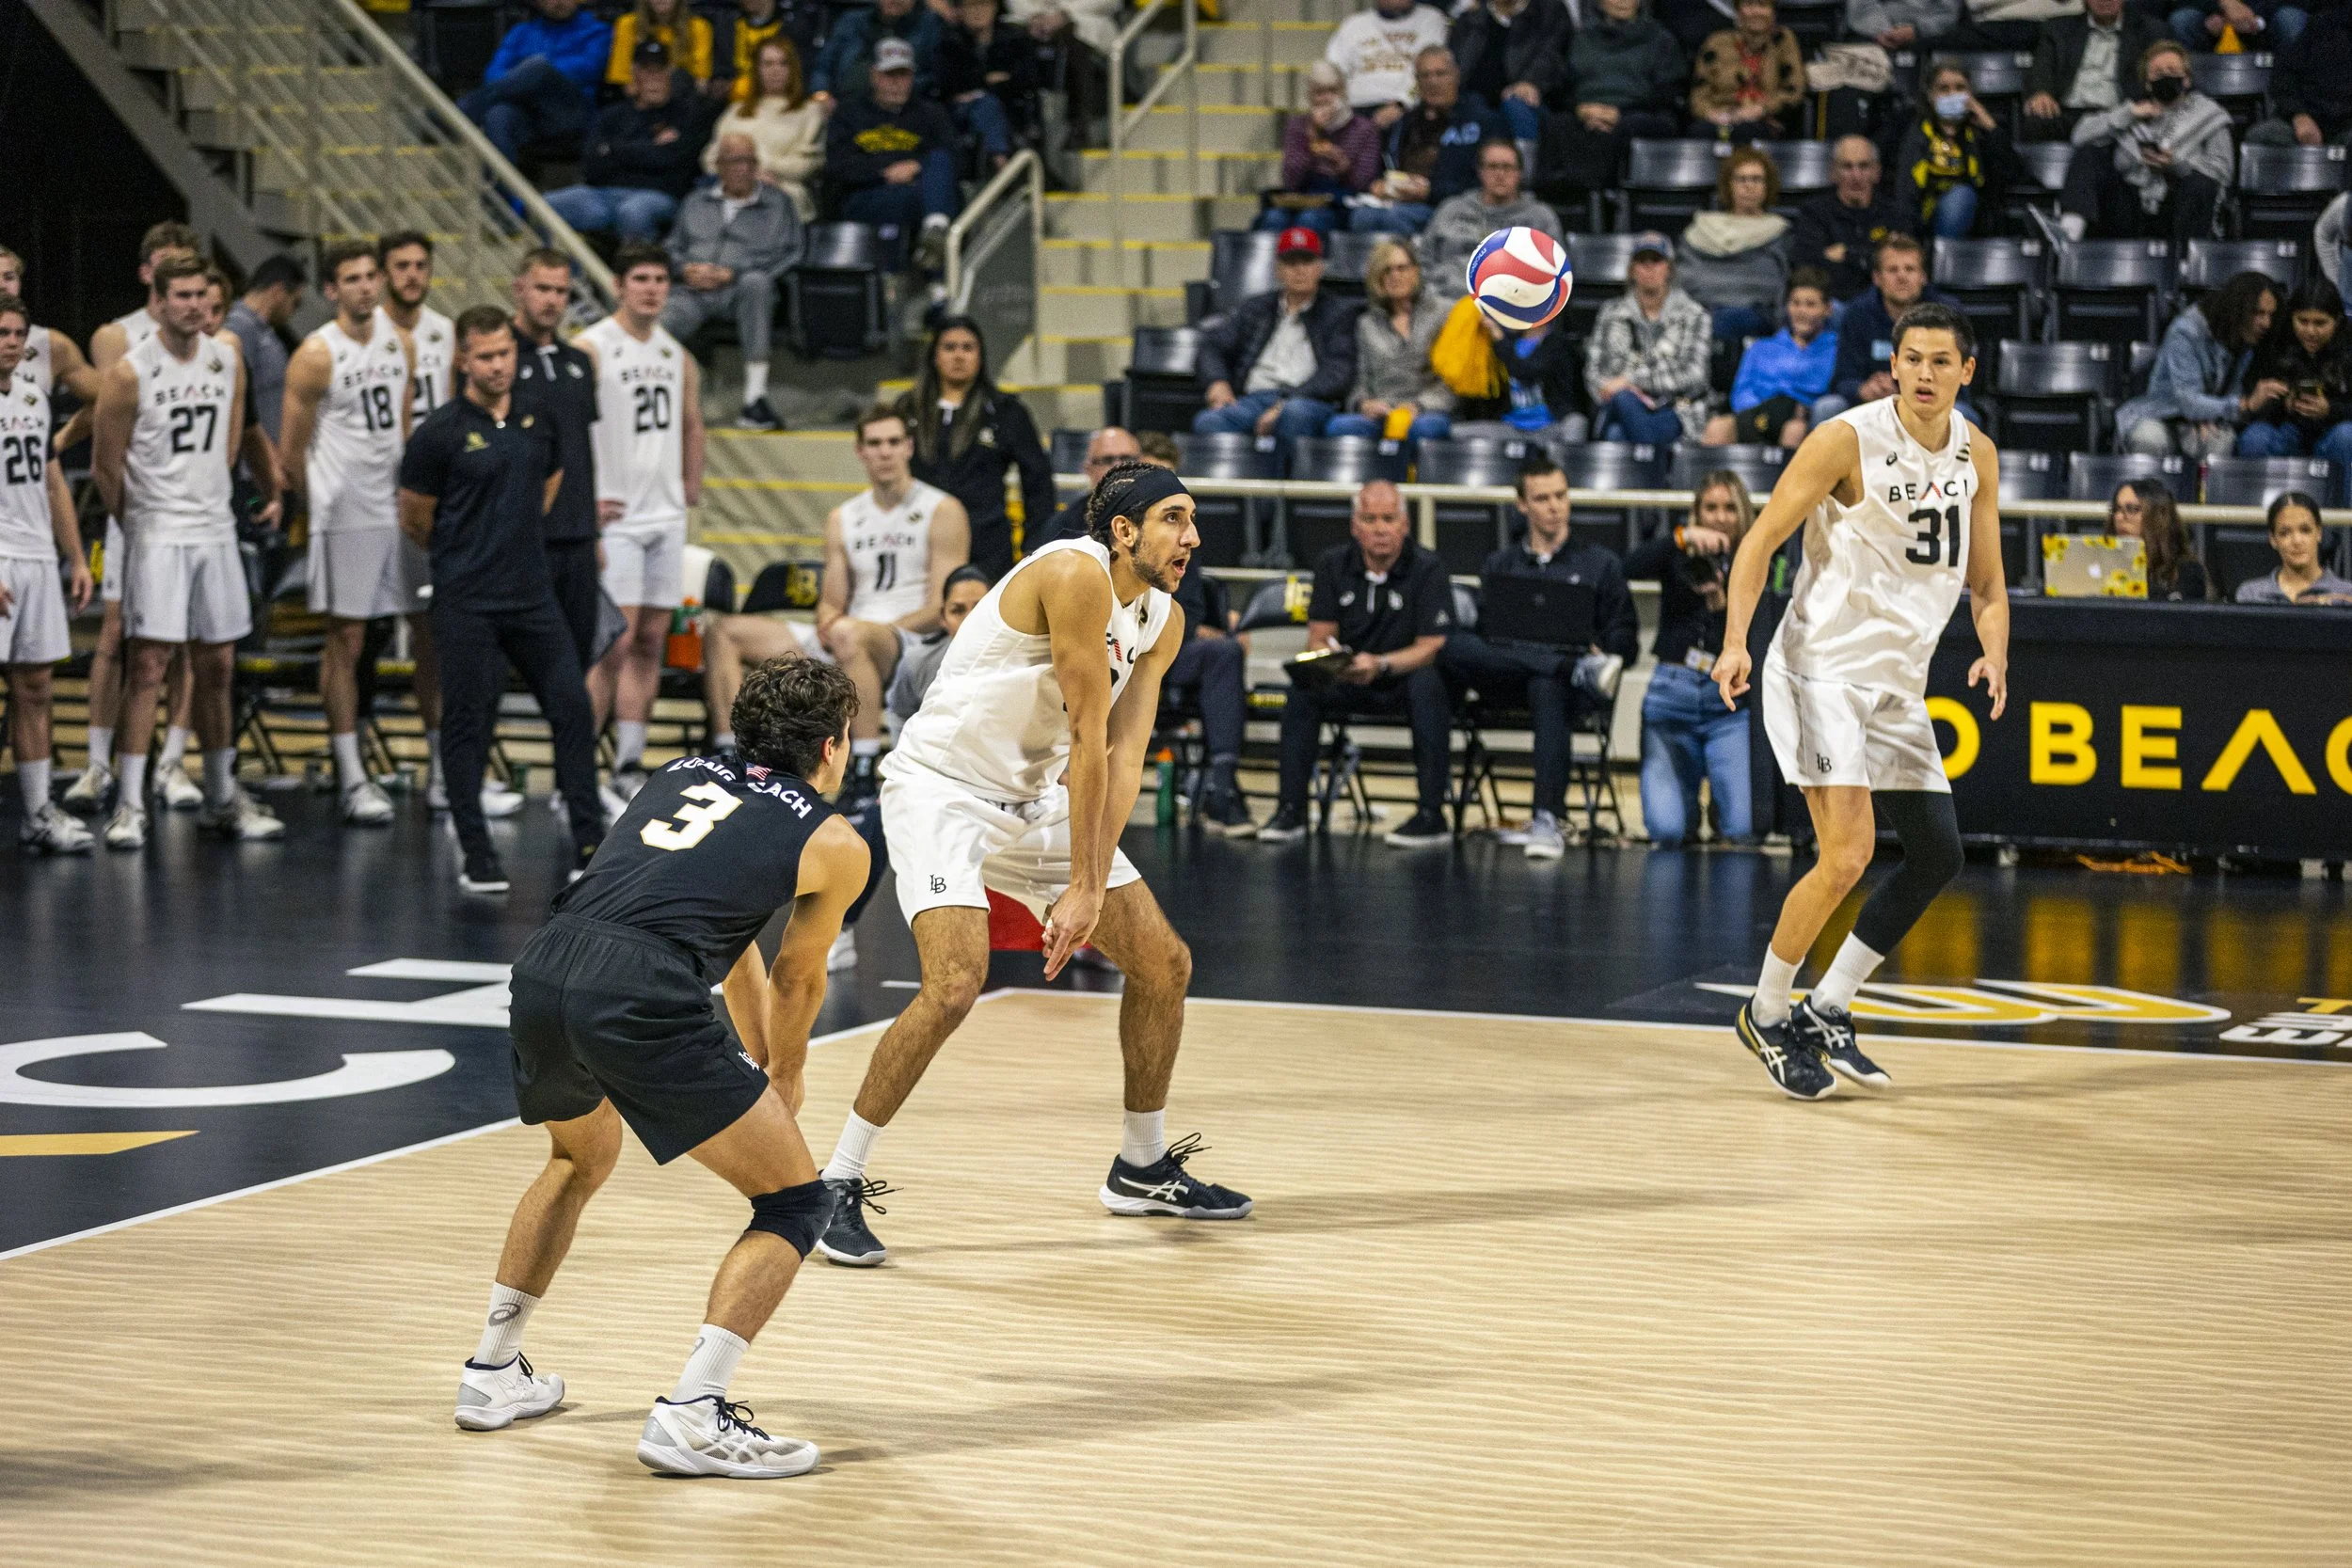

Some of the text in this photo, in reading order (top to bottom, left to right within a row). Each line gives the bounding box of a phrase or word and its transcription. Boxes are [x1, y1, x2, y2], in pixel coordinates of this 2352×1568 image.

[155, 384, 226, 405] BEACH
[360, 386, 394, 432] 18
[634, 385, 671, 433] 20
[0, 417, 45, 431] EACH
[170, 404, 218, 453] 27
[3, 436, 42, 484] 26
[1905, 505, 1961, 567] 31
[875, 552, 896, 592] 11
[640, 781, 743, 852] 3
[930, 874, 947, 895] LB
